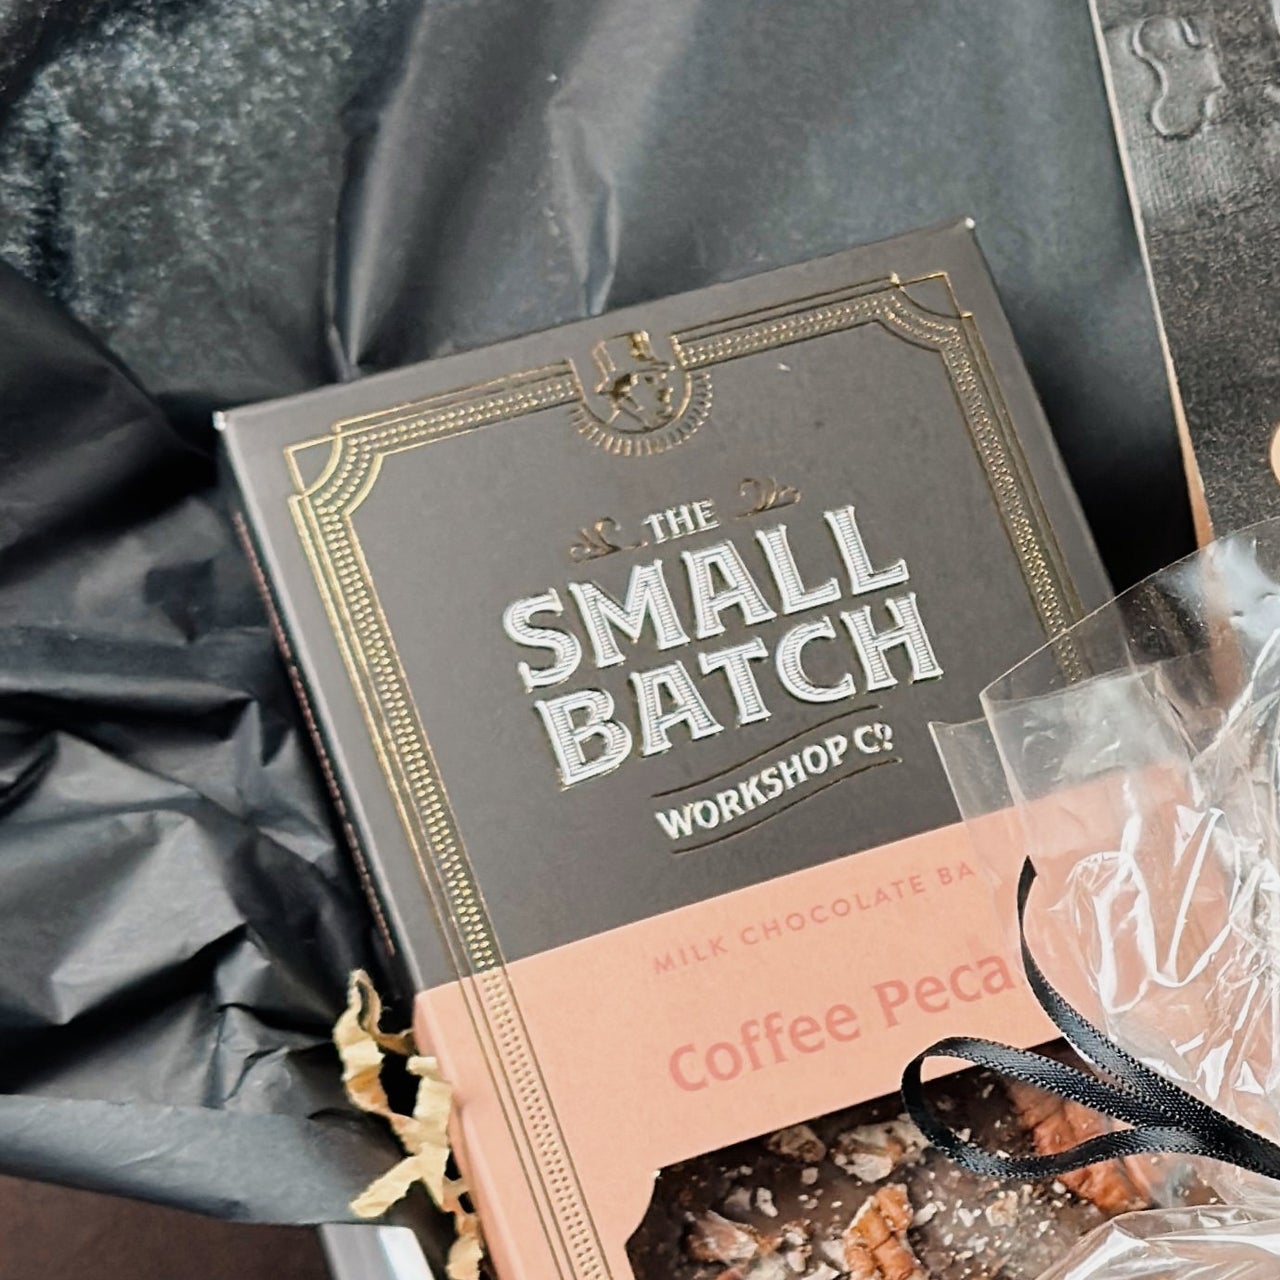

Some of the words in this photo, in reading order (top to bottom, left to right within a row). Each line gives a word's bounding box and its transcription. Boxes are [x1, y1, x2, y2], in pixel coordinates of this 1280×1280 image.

[643, 499, 719, 544] THE
[504, 506, 909, 692] SMALL
[534, 592, 943, 790] BATCH
[656, 734, 848, 840] WORKSHOP
[653, 934, 728, 975] MILK
[740, 873, 926, 947] CHOCOLATE
[936, 862, 975, 886] BA
[667, 1001, 862, 1092] Coffee
[872, 955, 1016, 1027] Peca
